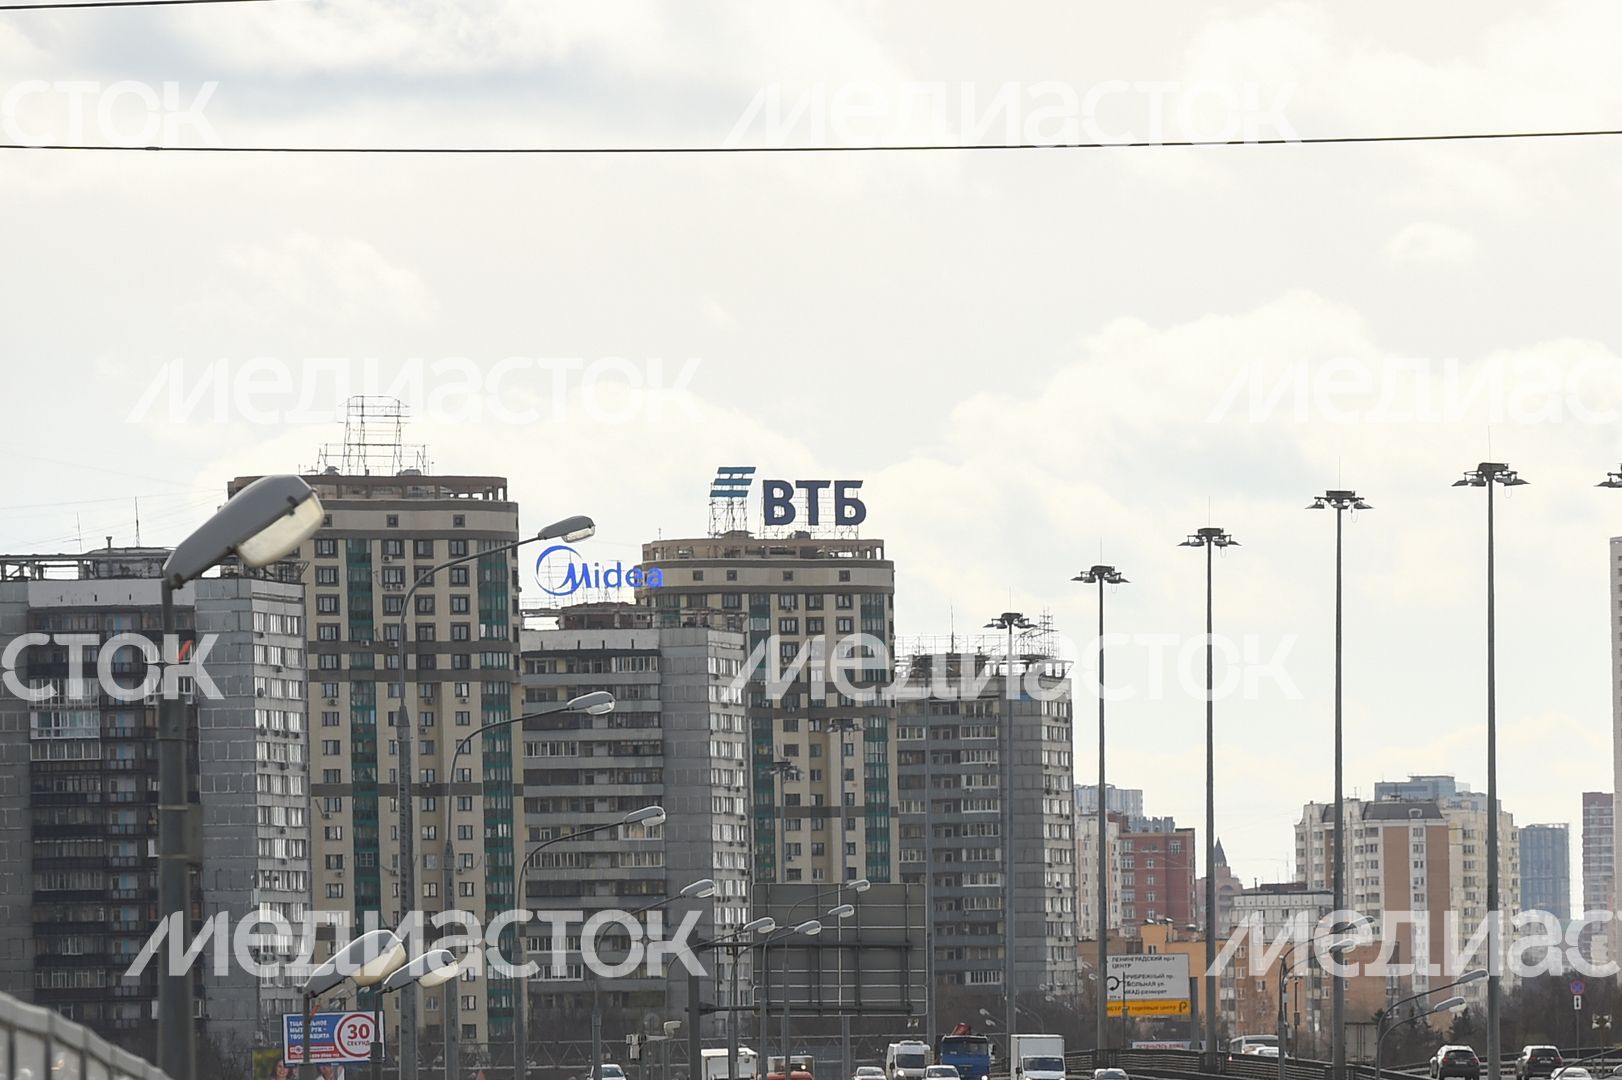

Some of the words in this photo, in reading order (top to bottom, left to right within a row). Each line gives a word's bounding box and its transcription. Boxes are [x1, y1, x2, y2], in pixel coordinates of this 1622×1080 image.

[762, 480, 866, 526] ВТБ
[536, 545, 664, 596] Midea
[347, 1024, 370, 1040] 30
